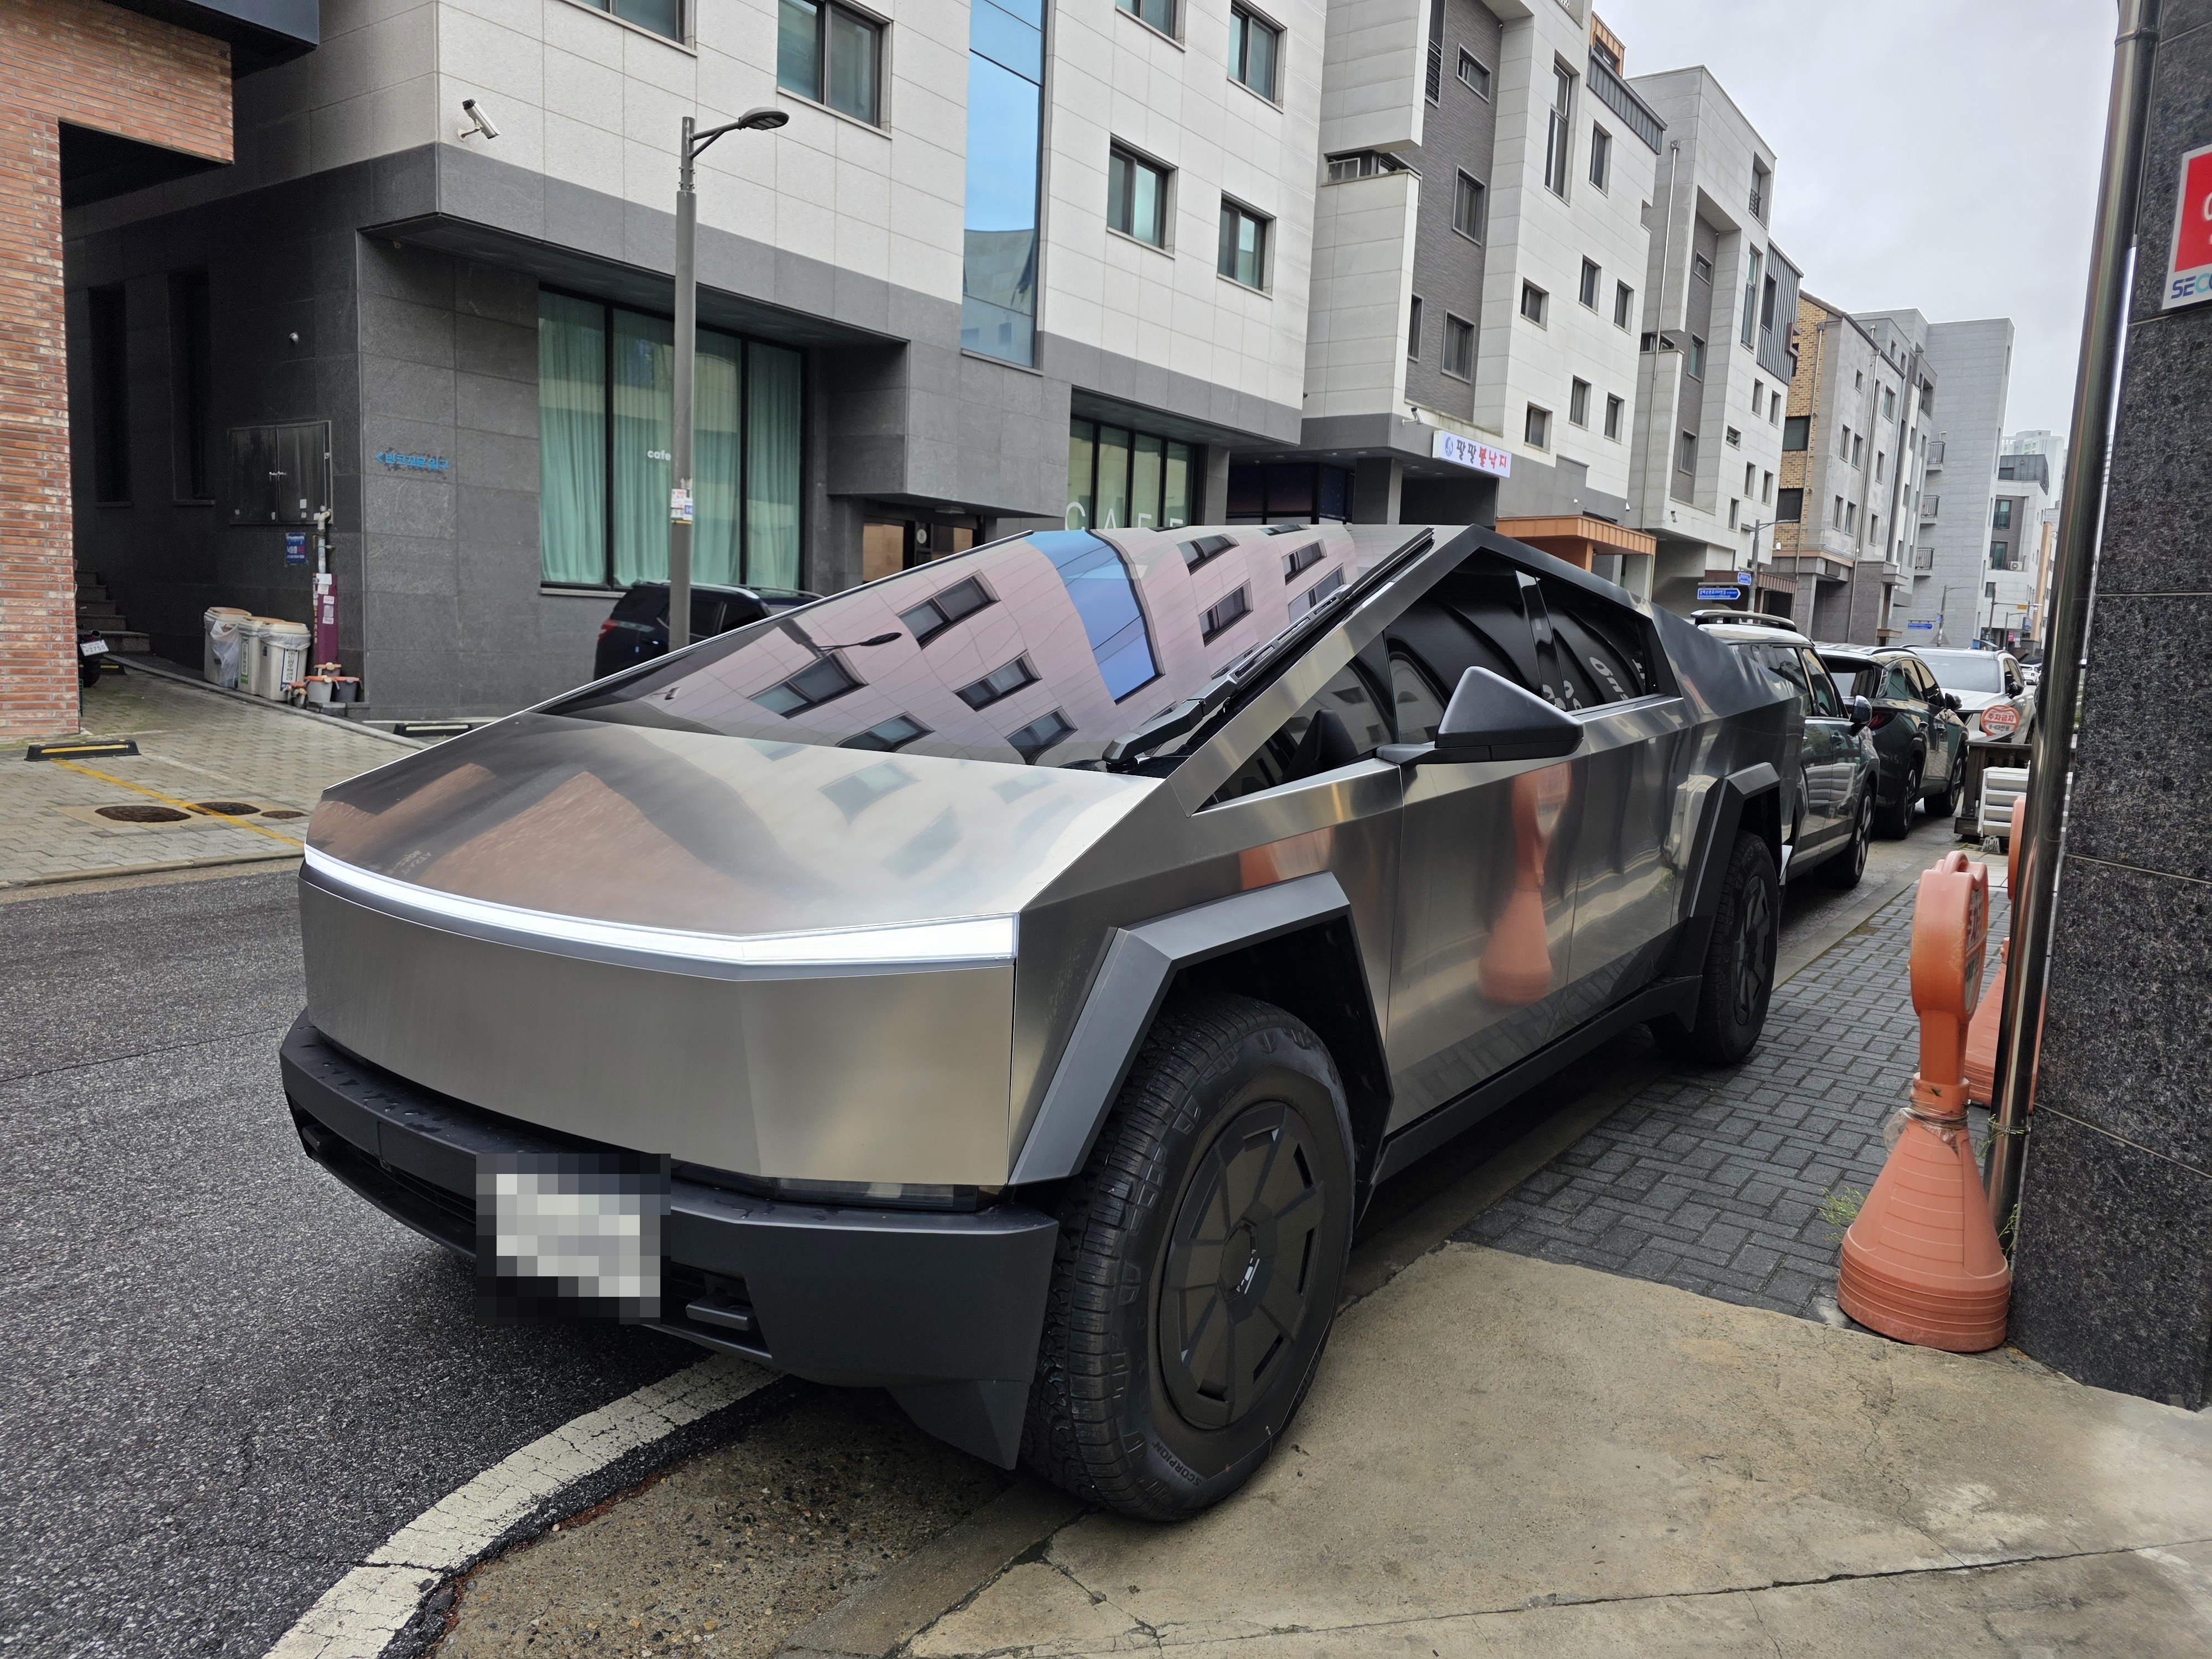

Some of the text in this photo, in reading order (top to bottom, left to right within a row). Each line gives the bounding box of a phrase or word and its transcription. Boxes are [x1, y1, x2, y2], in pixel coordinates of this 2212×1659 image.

[2171, 273, 2212, 299] SEC
[647, 450, 671, 461] cafe
[428, 457, 448, 469] 입구
[1988, 713, 2014, 722] 주차금지
[1152, 1441, 1202, 1486] SCORPION
